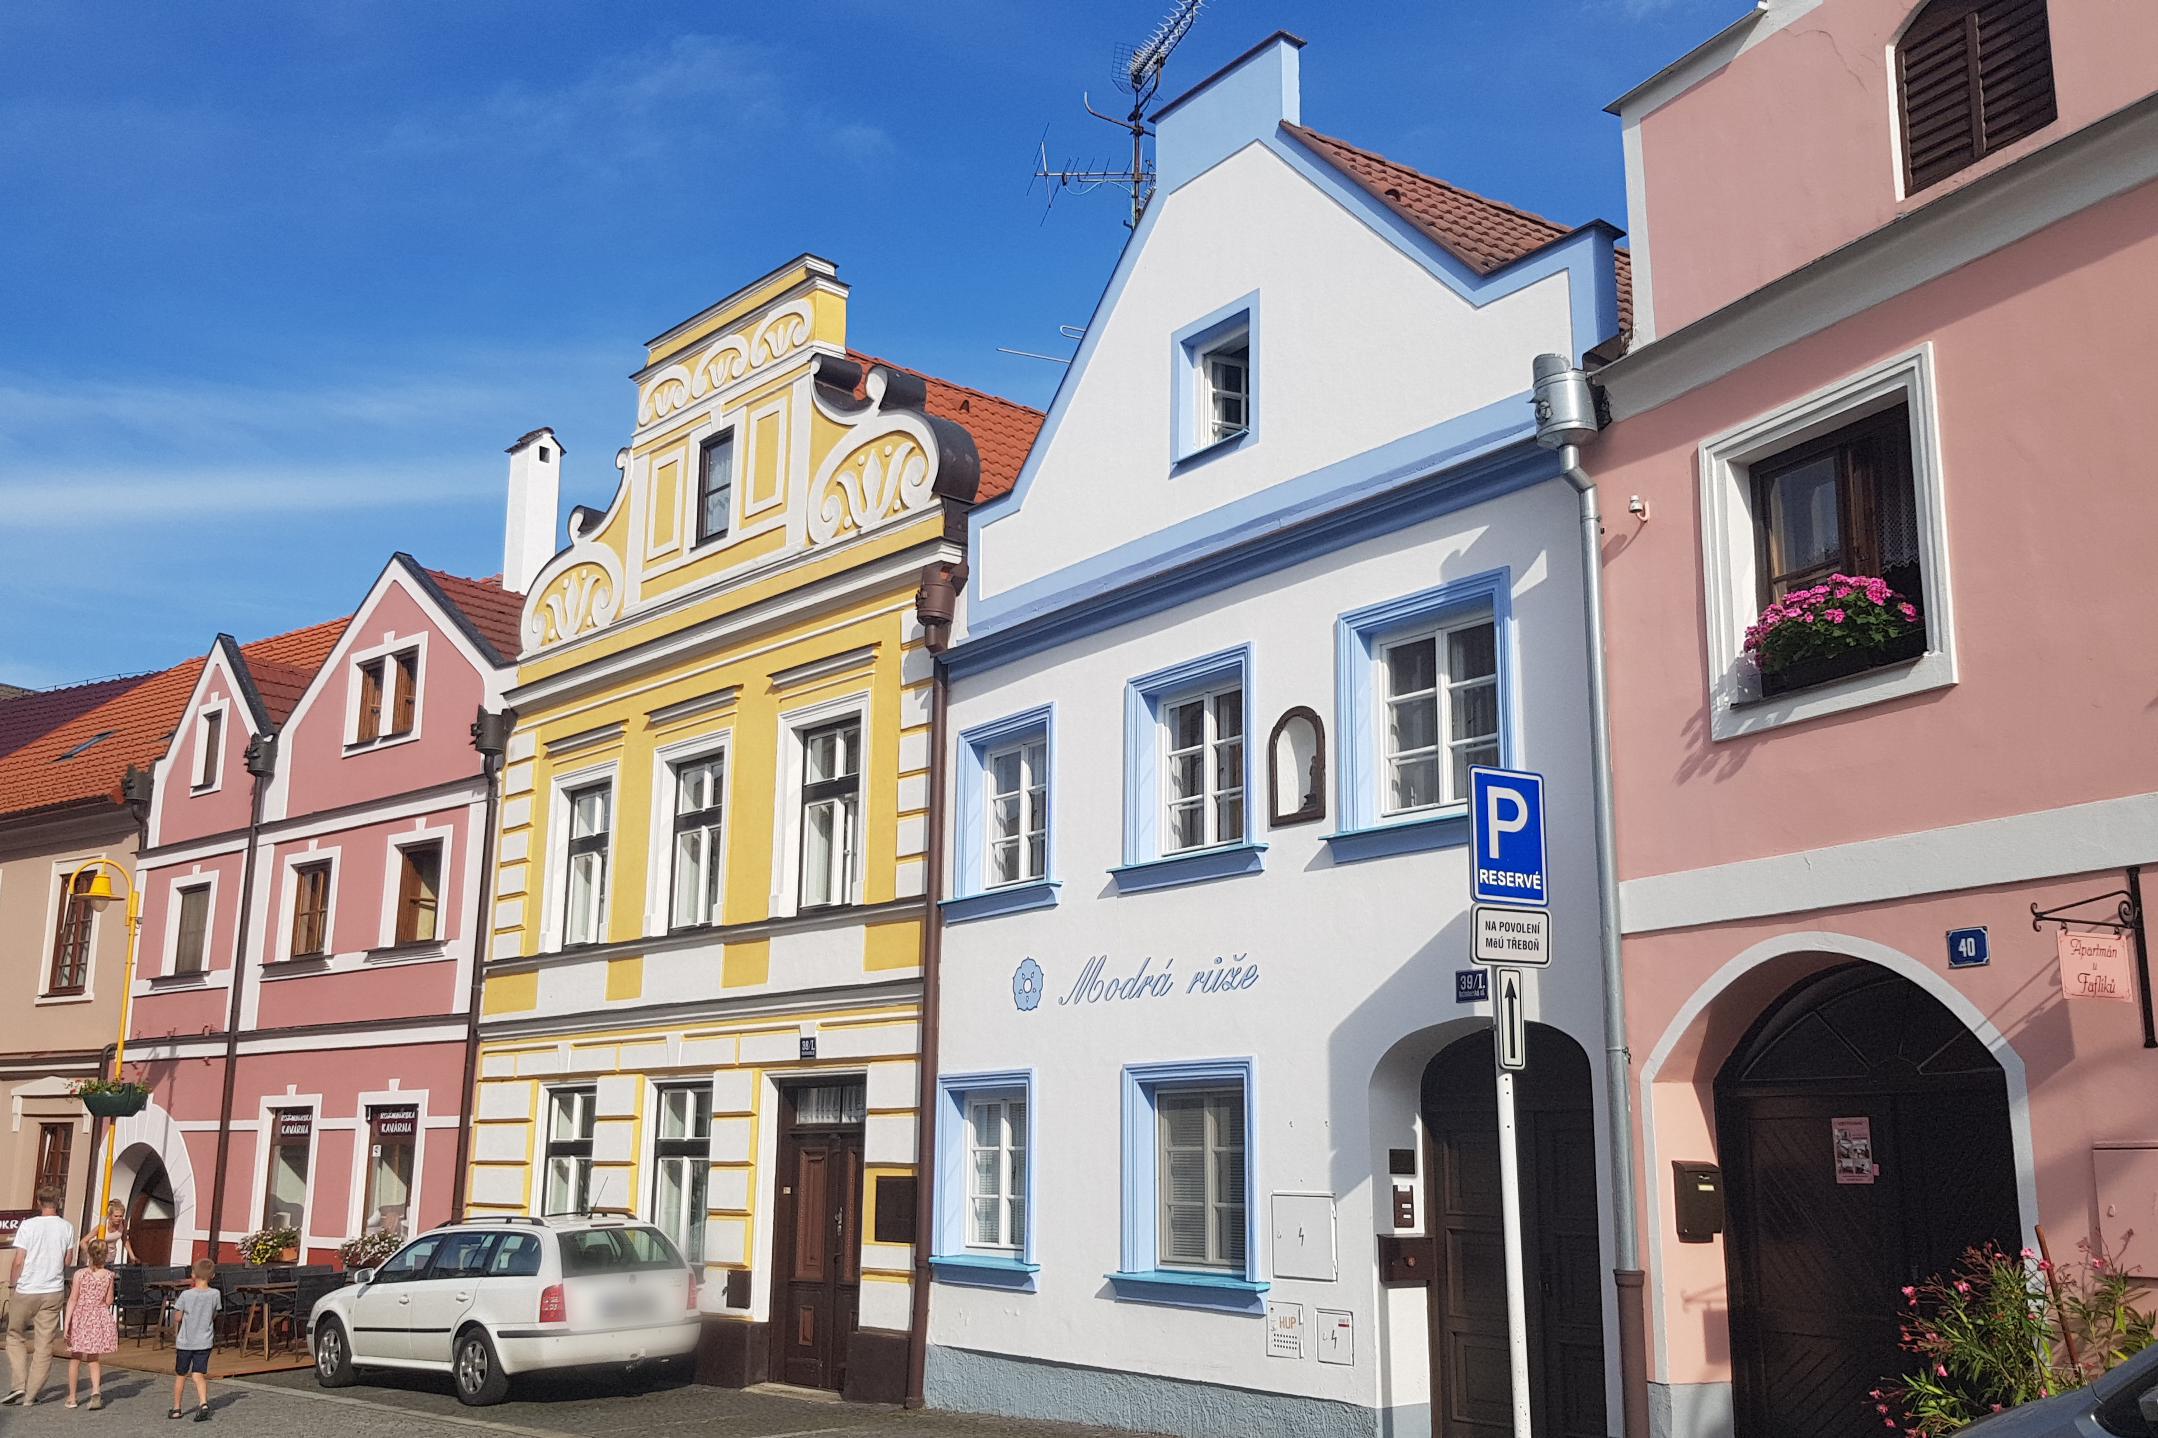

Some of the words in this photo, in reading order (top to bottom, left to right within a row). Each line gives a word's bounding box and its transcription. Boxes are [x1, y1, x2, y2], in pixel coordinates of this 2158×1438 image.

[1487, 785, 1529, 860] P
[1479, 868, 1542, 890] RESERVÉ
[1484, 920, 1498, 932] NA
[1499, 920, 1541, 935] POVOLENÍ
[1506, 936, 1540, 951] TŘEBOŇ
[1958, 937, 1976, 958] 40
[2070, 938, 2118, 960] Apartmán
[1058, 954, 1174, 1006] Modrá
[1186, 952, 1260, 995] růže
[281, 1122, 309, 1135] KAVÁRNA
[381, 1120, 412, 1133] KAVÁRNA
[1279, 1315, 1297, 1330] HUP
